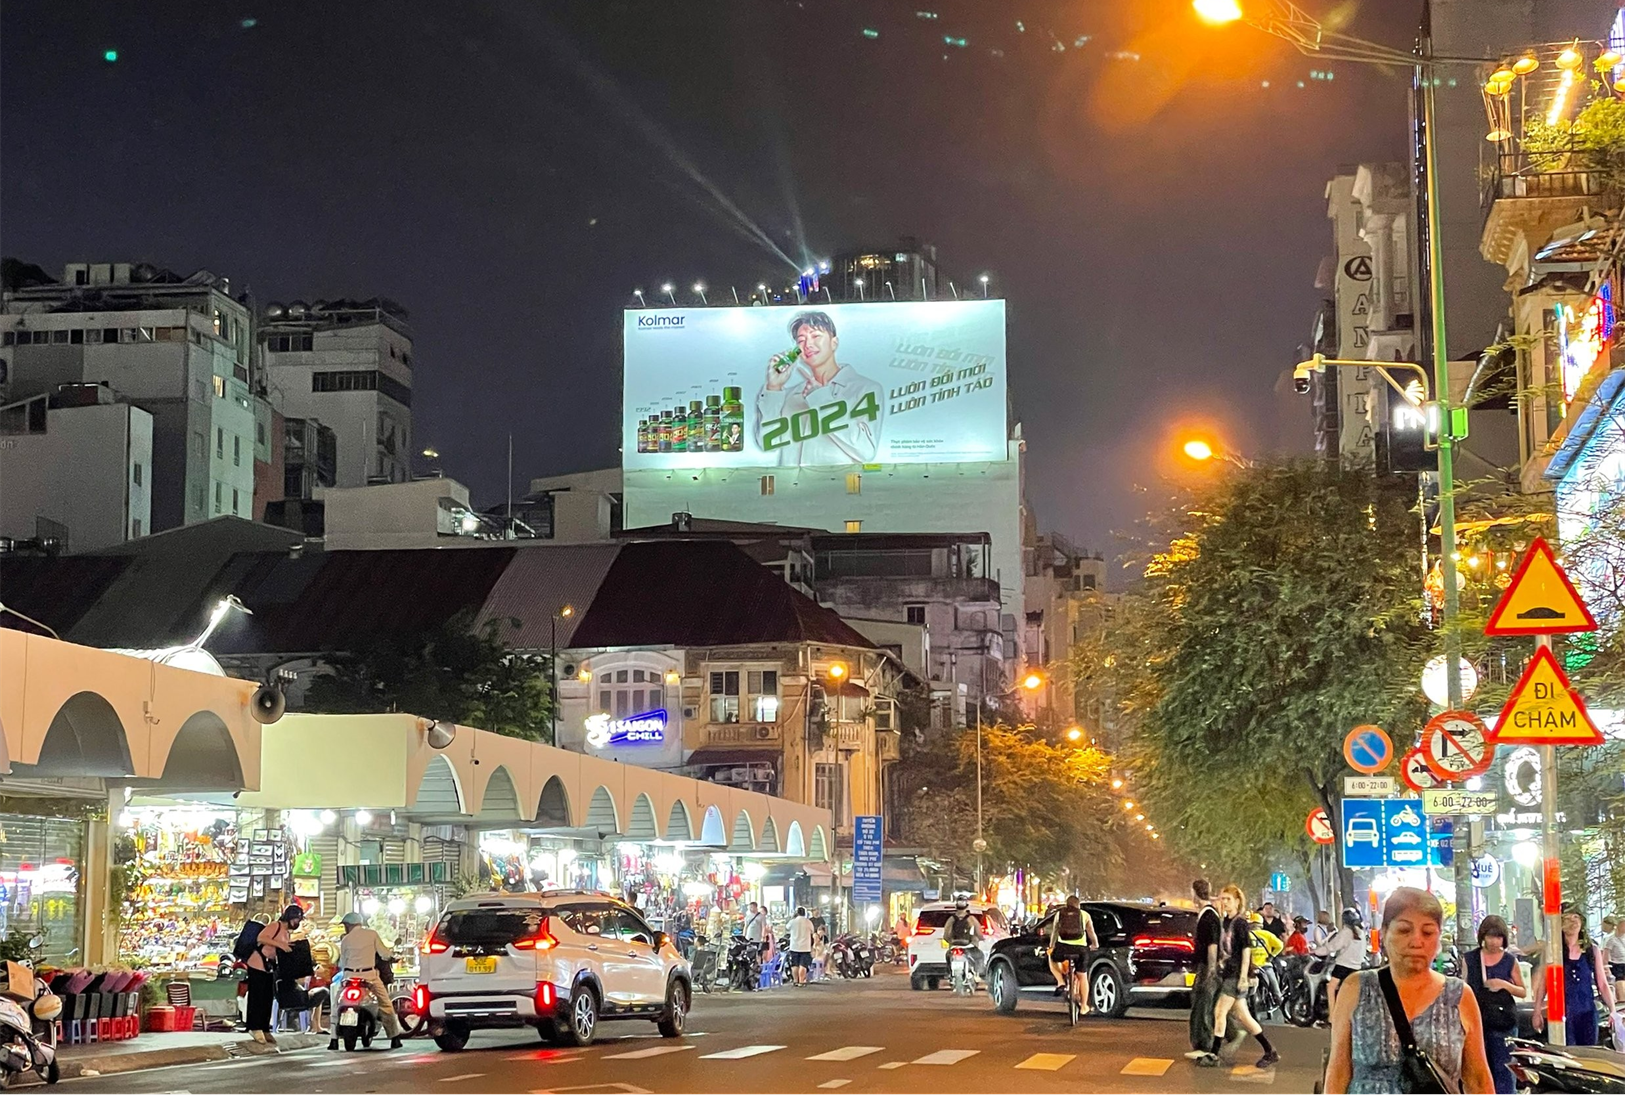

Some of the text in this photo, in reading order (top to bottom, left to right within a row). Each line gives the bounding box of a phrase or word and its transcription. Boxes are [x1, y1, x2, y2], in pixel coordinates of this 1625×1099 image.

[638, 315, 686, 326] Kolmar
[761, 391, 880, 451] 2024
[1534, 683, 1555, 700] ĐI
[1514, 708, 1576, 732] CHẬM
[627, 732, 664, 741] CHILL
